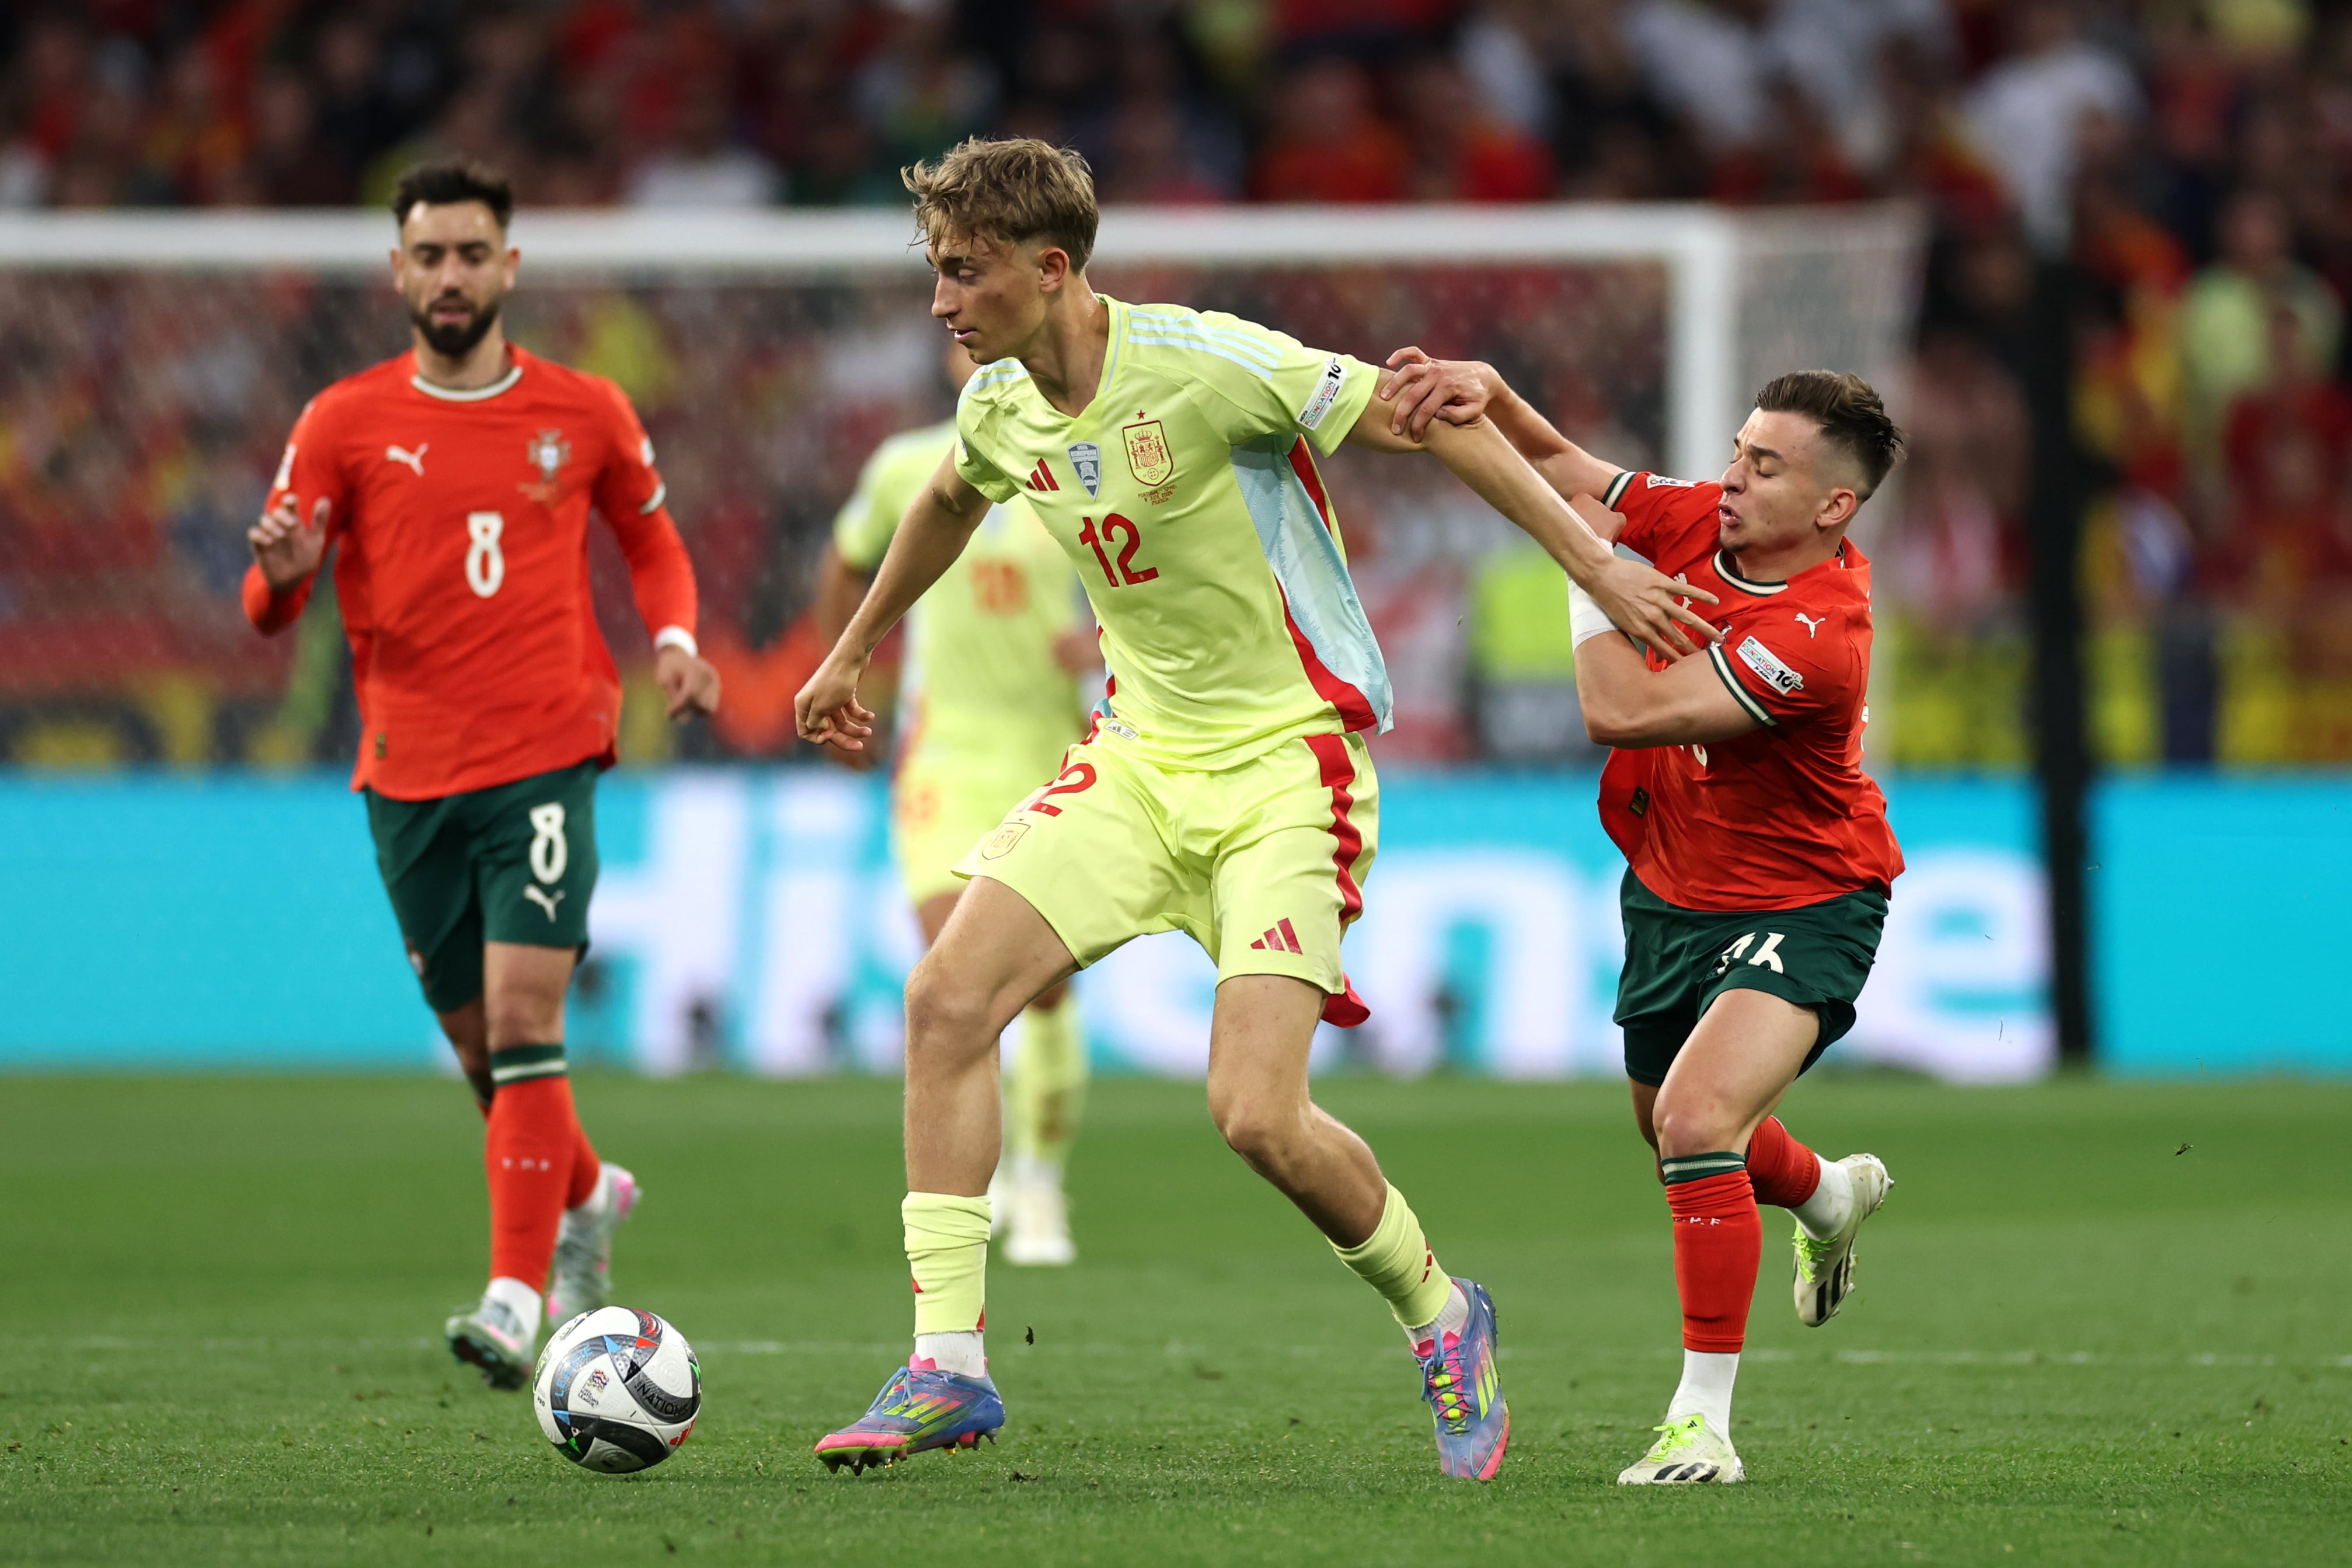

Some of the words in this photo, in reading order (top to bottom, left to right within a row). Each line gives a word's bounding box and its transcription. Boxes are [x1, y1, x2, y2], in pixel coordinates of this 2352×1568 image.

[1304, 380, 1334, 426] FOUNDATION
[465, 510, 506, 598] 8
[1078, 513, 1159, 587] 12
[1741, 643, 1776, 675] FOUNDATION
[1016, 762, 1097, 817] 2
[529, 801, 569, 884] 8
[636, 1383, 689, 1416] NATIONS
